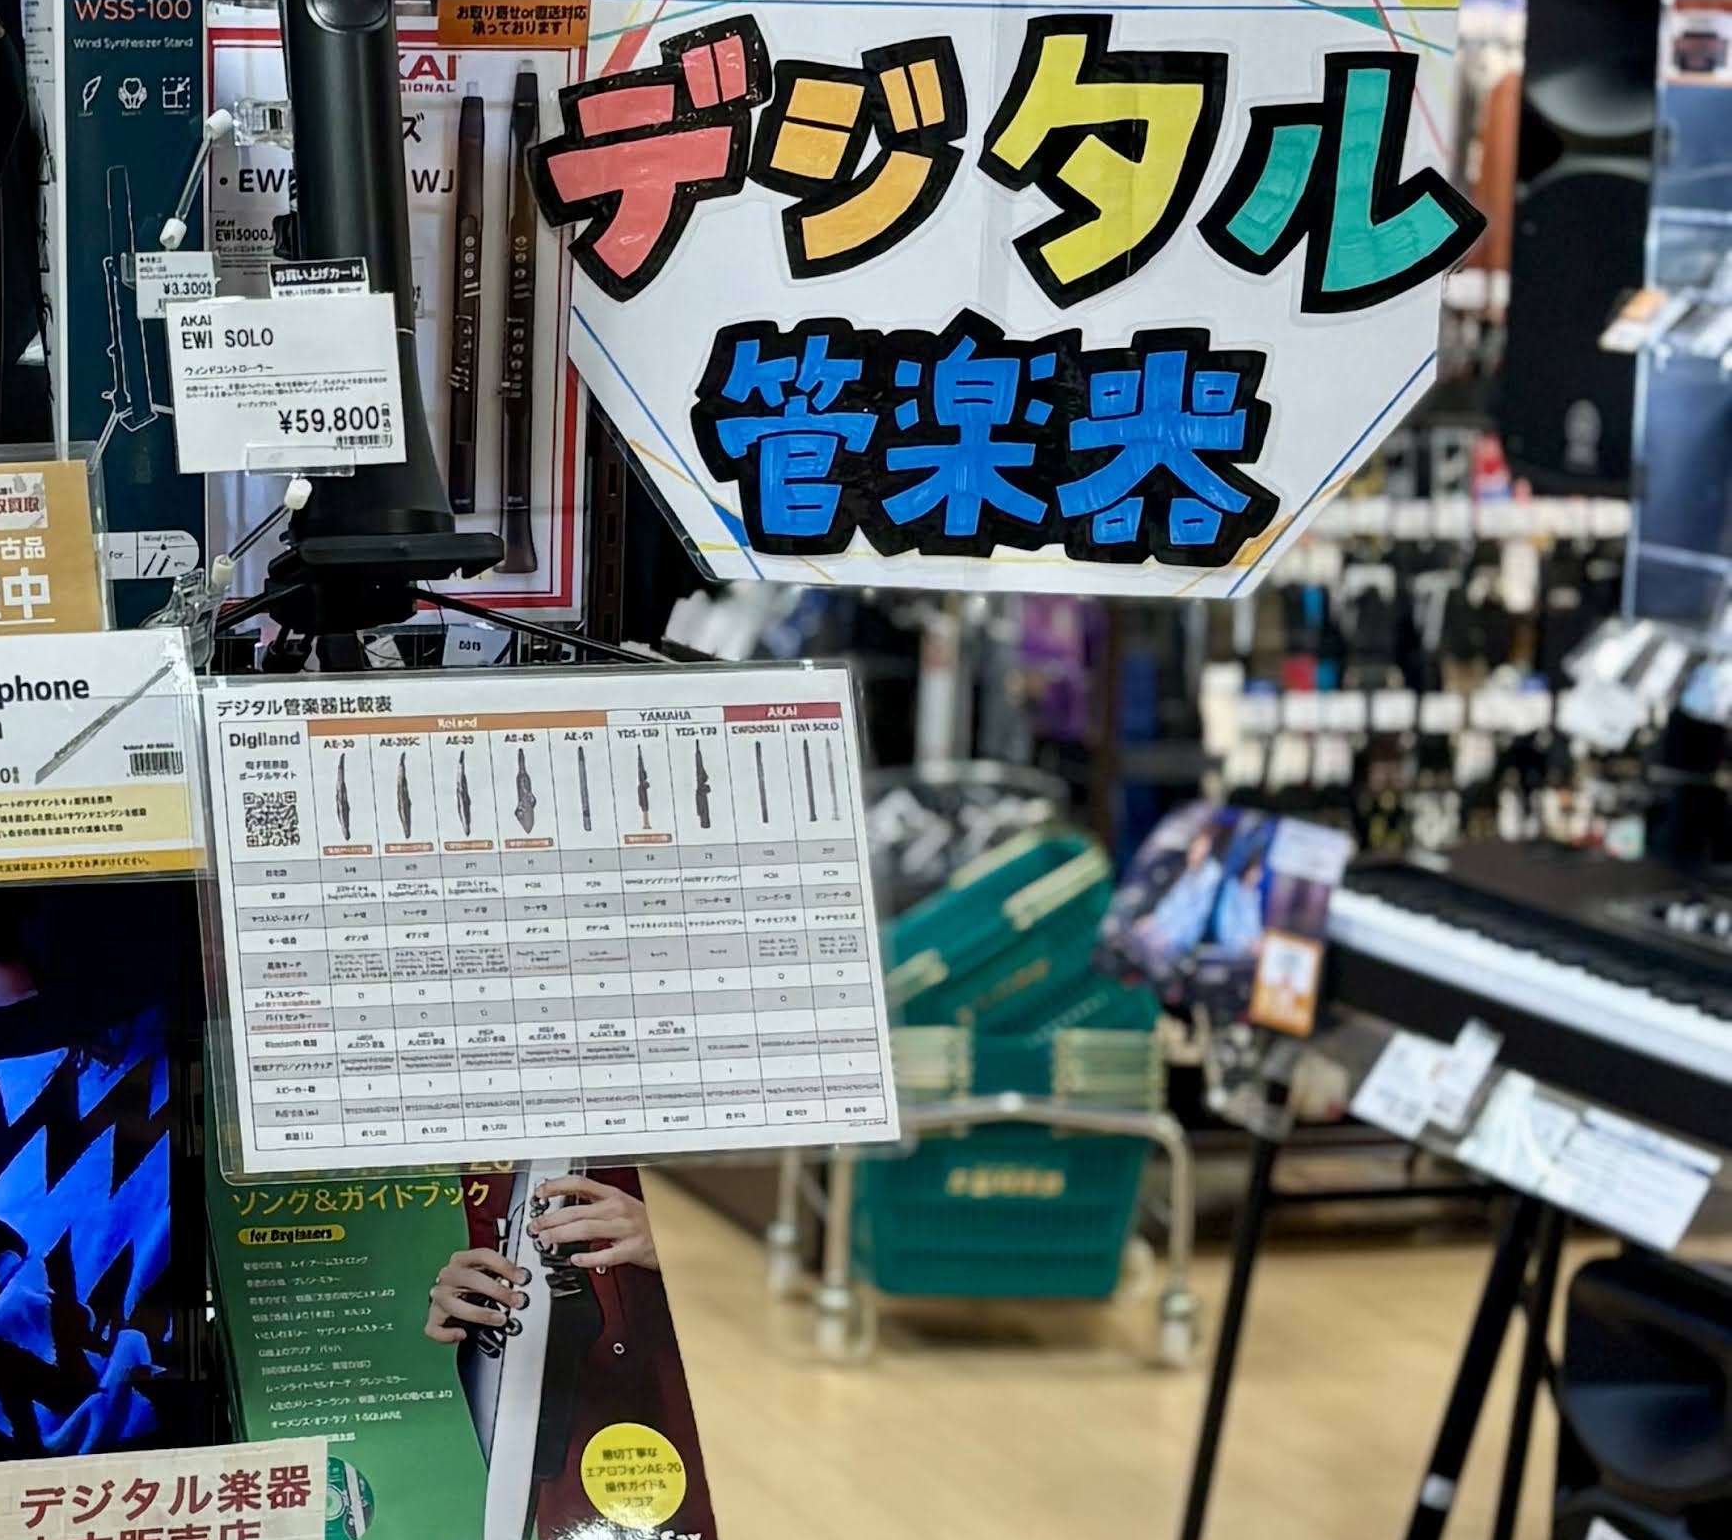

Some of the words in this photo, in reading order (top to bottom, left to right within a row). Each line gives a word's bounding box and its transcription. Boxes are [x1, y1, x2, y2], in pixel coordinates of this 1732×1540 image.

[456, 6, 587, 20] お取り寄せor直送対応
[164, 37, 193, 47] Stand
[528, 13, 1488, 314] デジタル
[181, 315, 211, 327] AKAI
[182, 331, 213, 350] EWI
[225, 328, 274, 348] SOLO
[278, 406, 379, 434] ¥59,800
[691, 308, 1281, 569] 管楽器
[217, 696, 393, 717] デジタル管楽器比較表
[233, 1181, 489, 1217] ソング&ガイドブック
[20, 1465, 312, 1529] デジタル楽器
